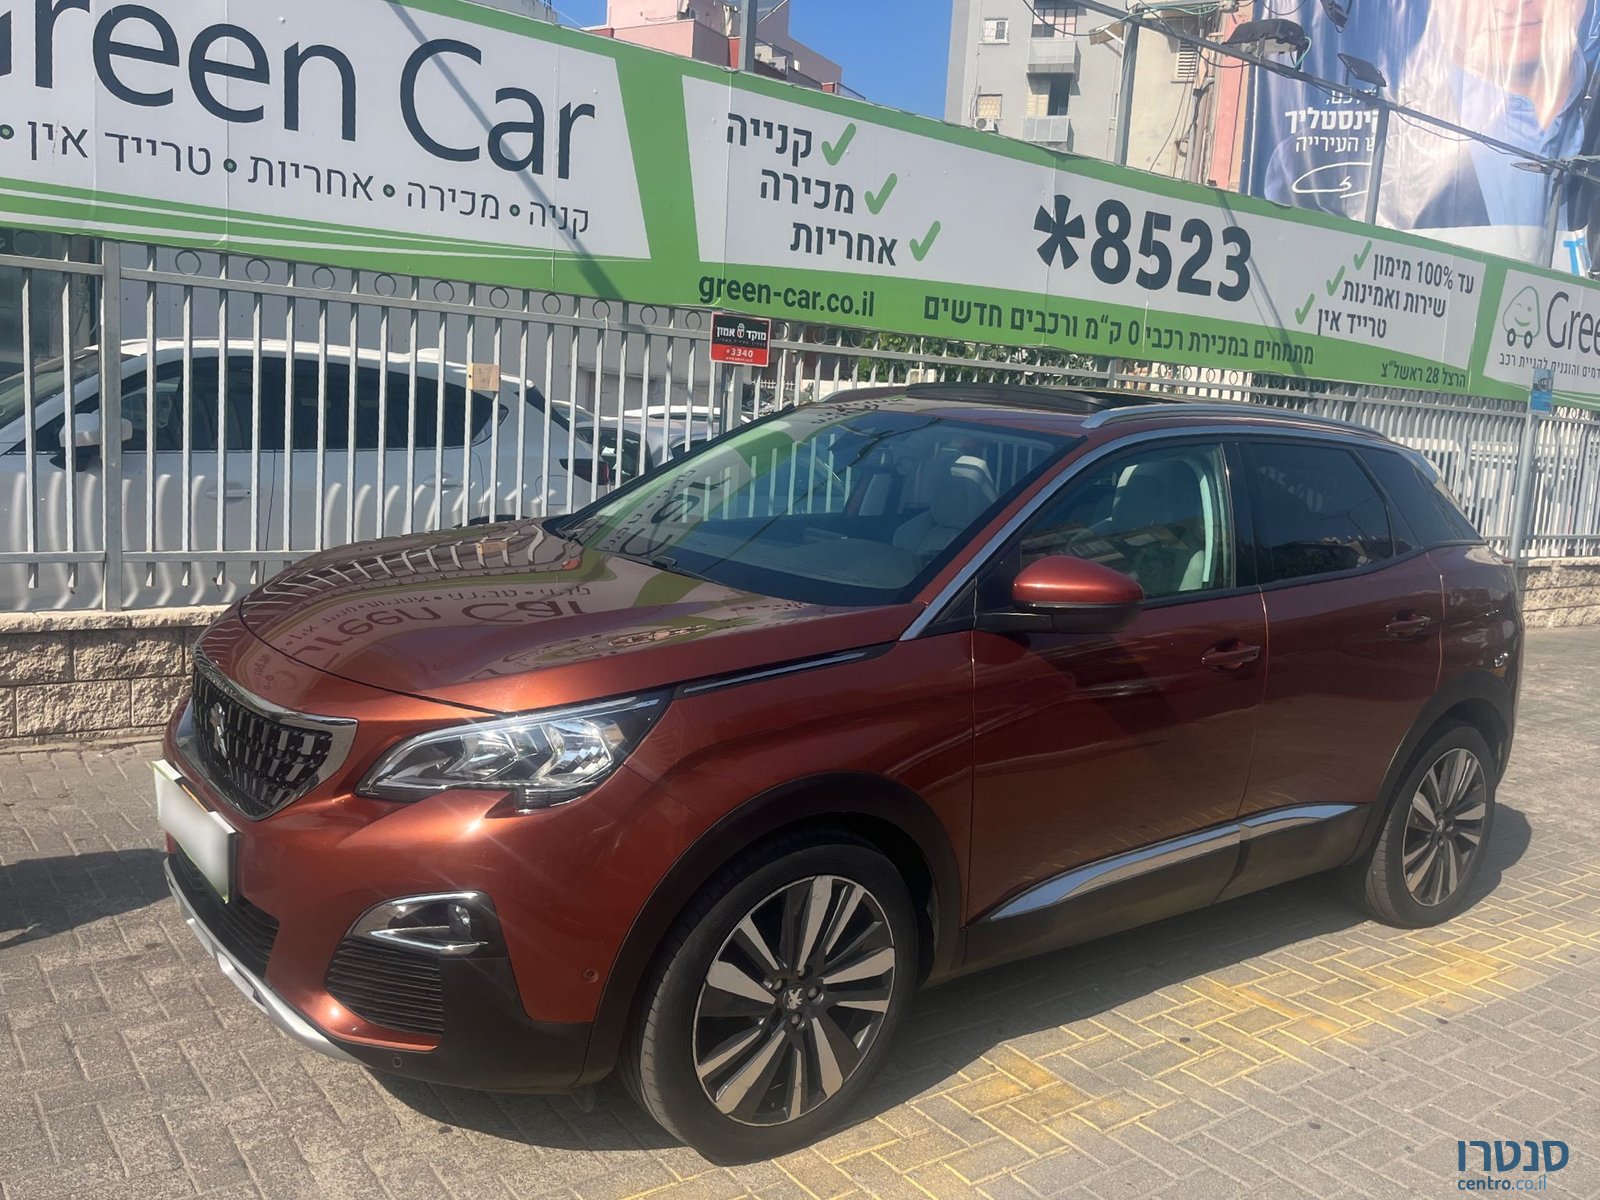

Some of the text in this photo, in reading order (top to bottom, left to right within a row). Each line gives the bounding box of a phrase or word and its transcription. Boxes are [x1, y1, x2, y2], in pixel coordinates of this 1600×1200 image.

[0, 0, 596, 180] reen Car
[727, 112, 812, 167] קנייה
[1295, 136, 1359, 153] העירייה
[27, 120, 590, 239] קניה מכירה אחריות טרייד אין
[760, 168, 854, 215] מכירה
[790, 221, 897, 266] אחריות
[1373, 252, 1474, 294] עד 100% מימון
[699, 274, 875, 317] green-car.co.il
[924, 295, 1003, 329] חדשים
[1342, 280, 1446, 318] שירות ואמינות
[746, 330, 767, 341] מוקד
[1011, 306, 1078, 339] ורכבים
[1128, 322, 1139, 346] 0
[1146, 324, 1184, 351] רכבי
[1317, 307, 1387, 339] טרייד אין
[1187, 330, 1249, 359] במכירת
[1254, 338, 1314, 365] מתמחים
[1426, 368, 1440, 384] 28
[1442, 369, 1466, 388] הרצל
